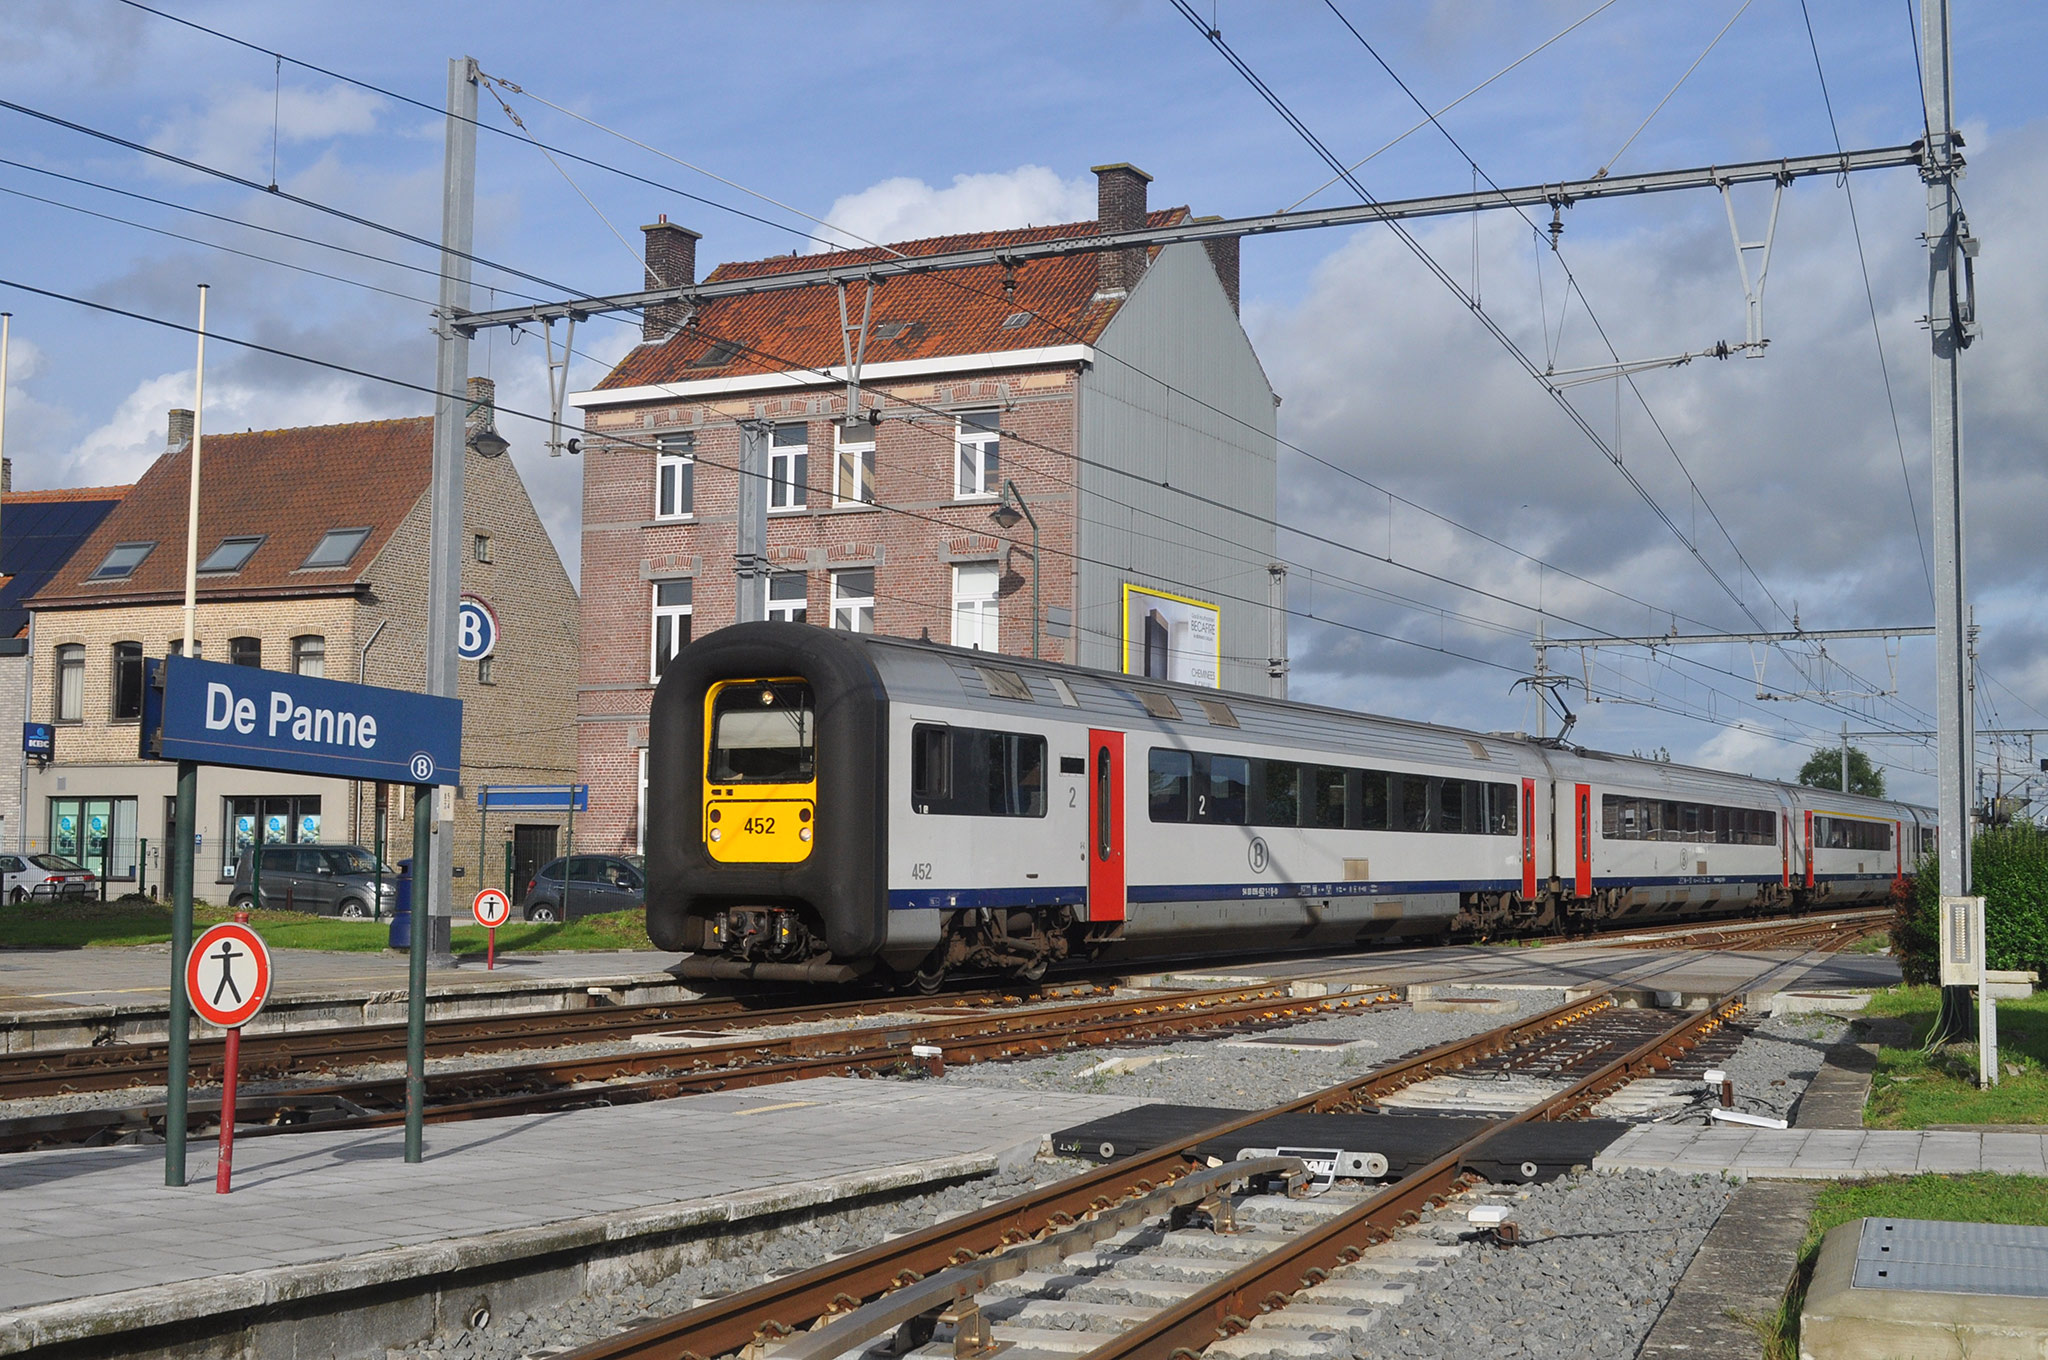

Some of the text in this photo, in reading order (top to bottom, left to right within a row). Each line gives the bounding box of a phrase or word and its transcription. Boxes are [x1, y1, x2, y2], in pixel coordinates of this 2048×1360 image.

[459, 611, 482, 651] B
[205, 682, 377, 749] De Panne
[28, 739, 50, 748] KBC
[1069, 786, 1076, 808] 2
[1199, 795, 1205, 815] 2
[744, 817, 776, 835] 452
[1501, 814, 1506, 829] 2
[912, 862, 932, 881] 452
